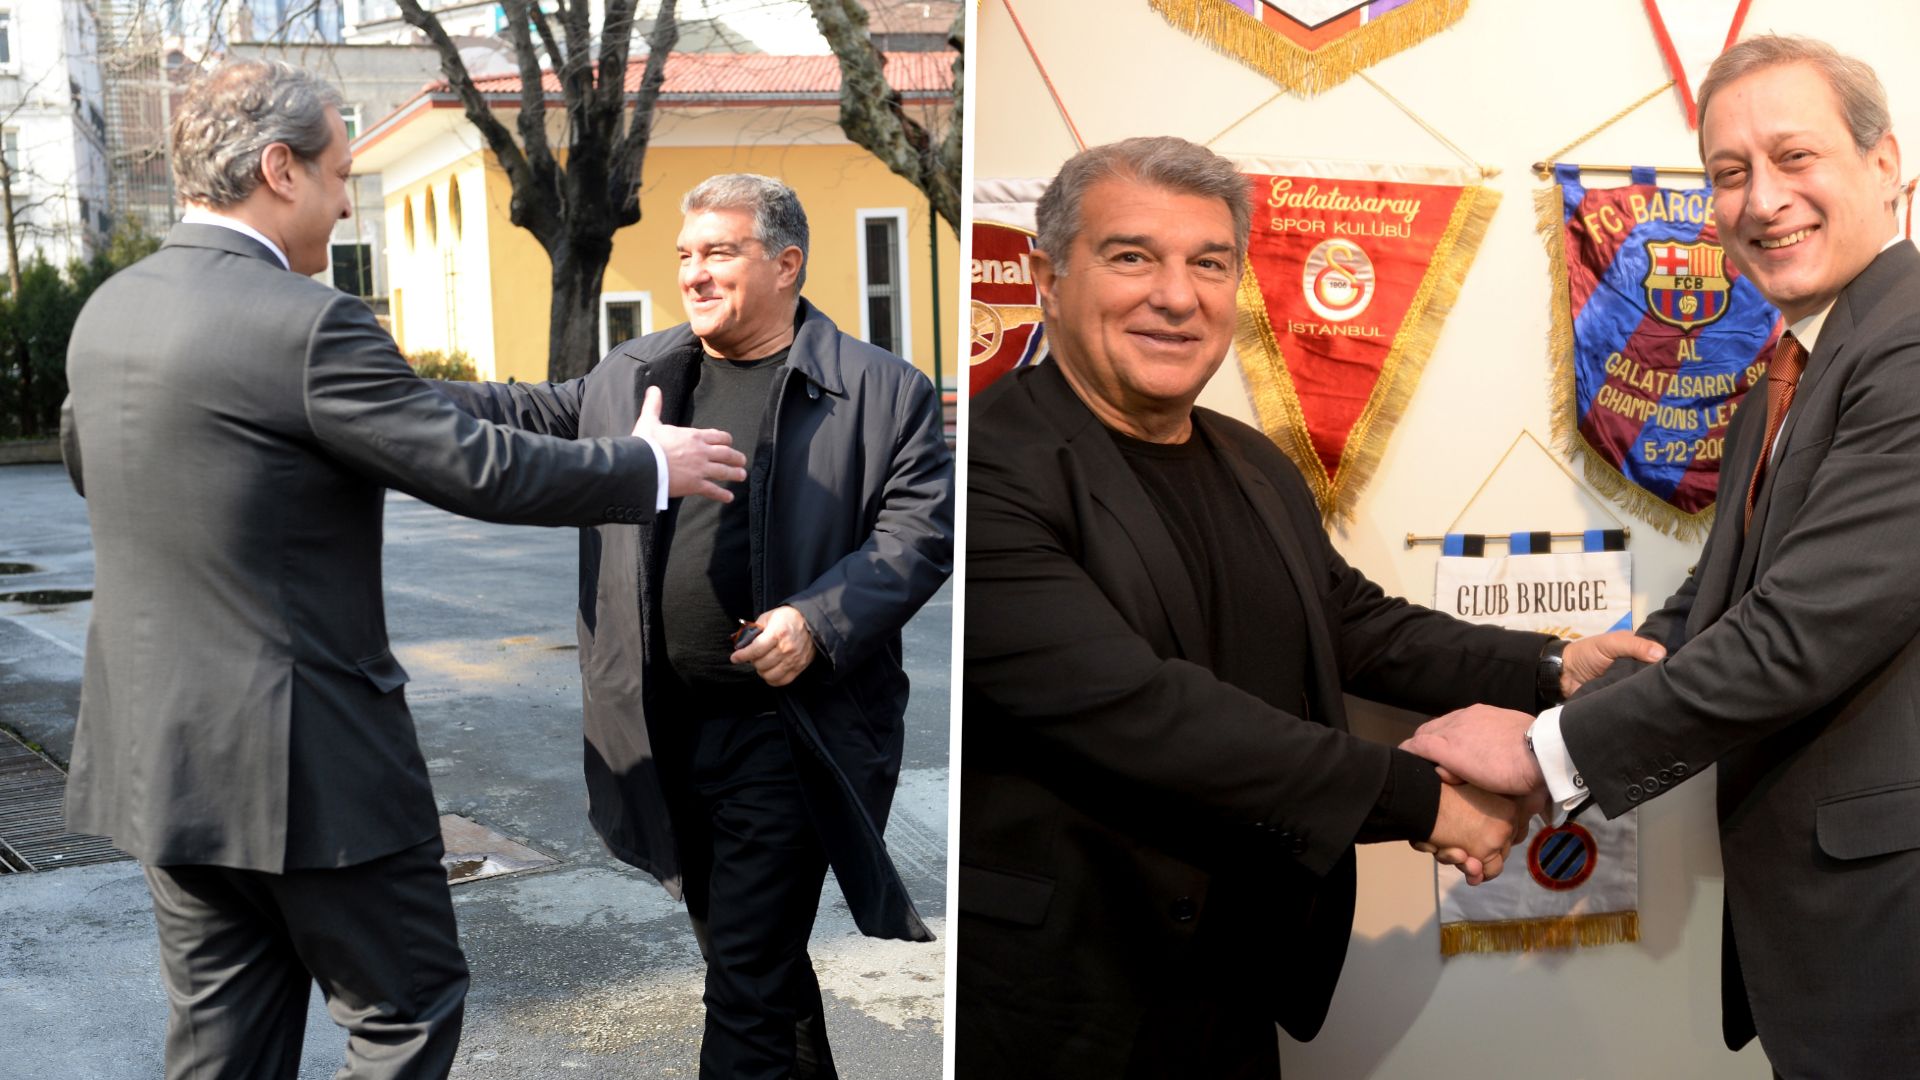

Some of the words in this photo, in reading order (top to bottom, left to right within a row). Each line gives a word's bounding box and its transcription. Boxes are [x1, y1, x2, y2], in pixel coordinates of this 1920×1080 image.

[1267, 176, 1421, 223] Galatasaray
[1270, 218, 1325, 233] SPOR
[1333, 221, 1411, 239] KULÜBÜ
[1583, 205, 1624, 244] FC
[1674, 277, 1704, 289] FCB
[1287, 320, 1387, 337] İSTANBUL
[1677, 339, 1702, 362] AL
[1604, 352, 1737, 398] GALATASARAY
[1598, 384, 1699, 430] CHAMPIONS
[1456, 583, 1509, 616] CLUB
[1516, 580, 1608, 614] BRUGGE
